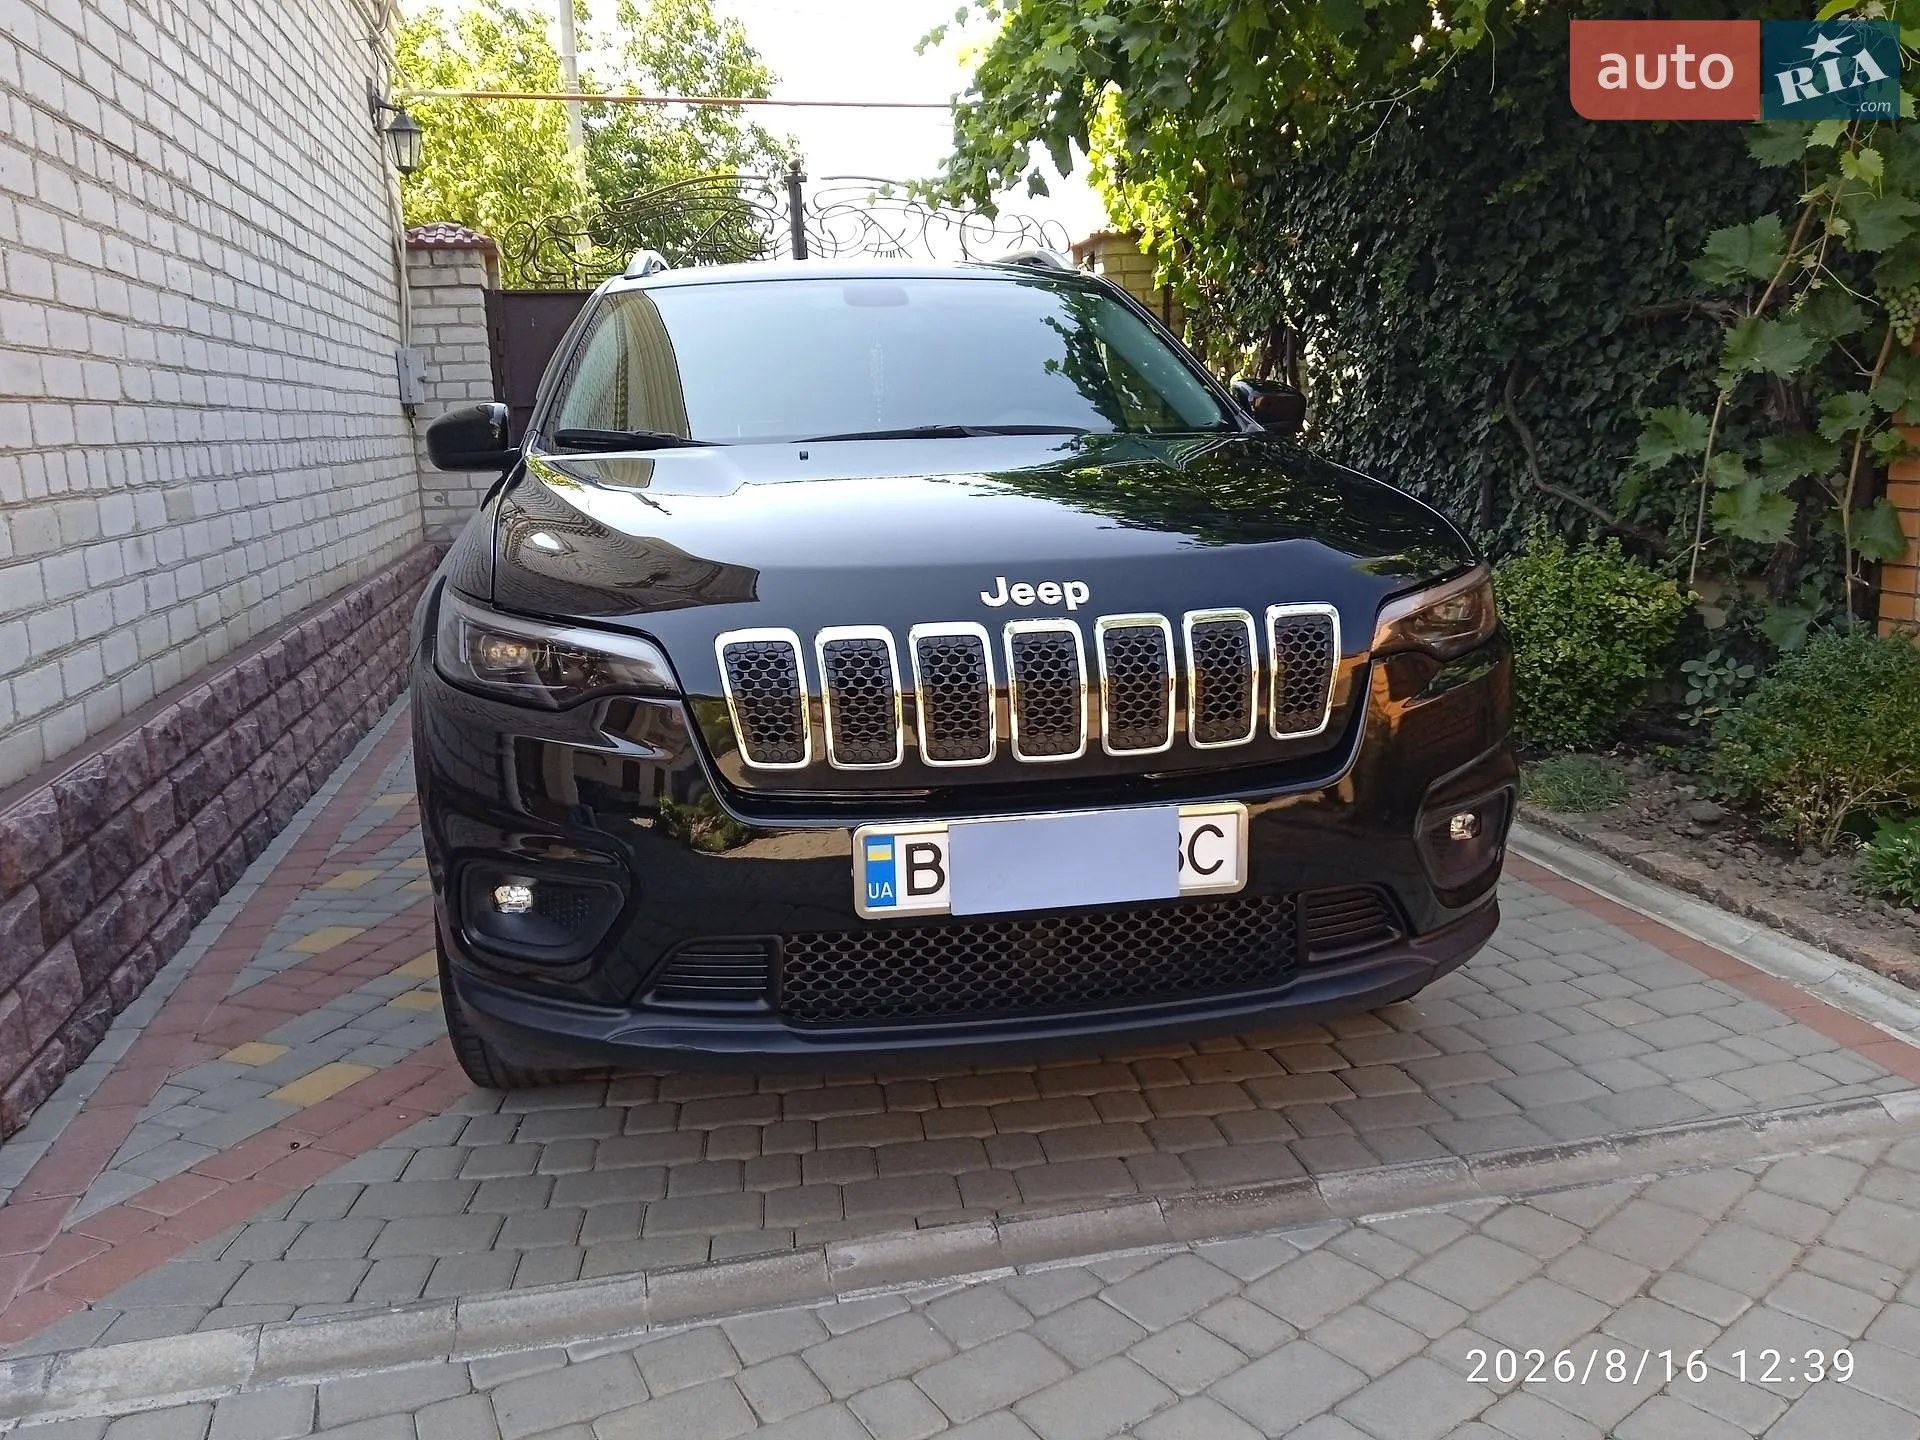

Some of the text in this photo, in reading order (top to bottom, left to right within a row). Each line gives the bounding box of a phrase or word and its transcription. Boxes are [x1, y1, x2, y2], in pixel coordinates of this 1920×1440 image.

[980, 576, 1090, 611] Jeep
[1178, 823, 1225, 876] C
[868, 881, 893, 900] UA
